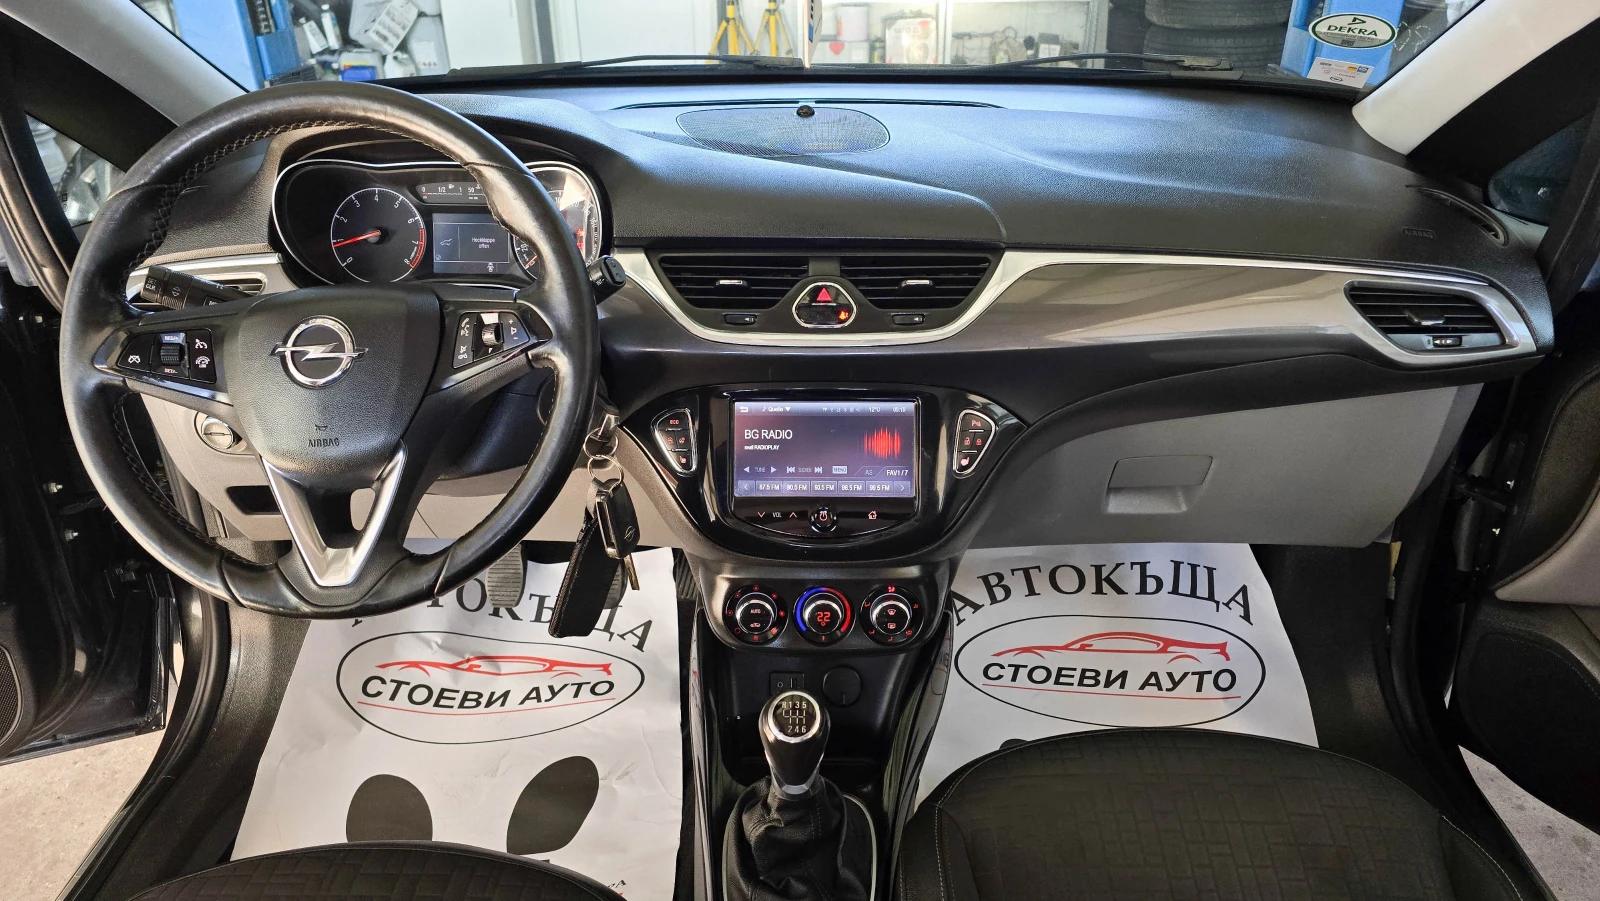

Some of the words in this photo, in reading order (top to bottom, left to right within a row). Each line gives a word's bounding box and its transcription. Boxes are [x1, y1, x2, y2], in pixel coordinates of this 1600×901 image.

[1327, 24, 1378, 37] DEKRA
[354, 200, 360, 208] 3
[394, 201, 400, 209] 5
[744, 429, 759, 440] BG
[761, 429, 793, 440] RADIO
[307, 437, 340, 448] AIRBAG
[948, 559, 1254, 627] АВТОКЪЩА
[817, 611, 831, 622] 22
[982, 662, 1130, 690] СТОЕВИ
[1138, 668, 1237, 693] АУТО
[361, 675, 511, 710] СТОЕВИ
[518, 680, 615, 706] АУТО
